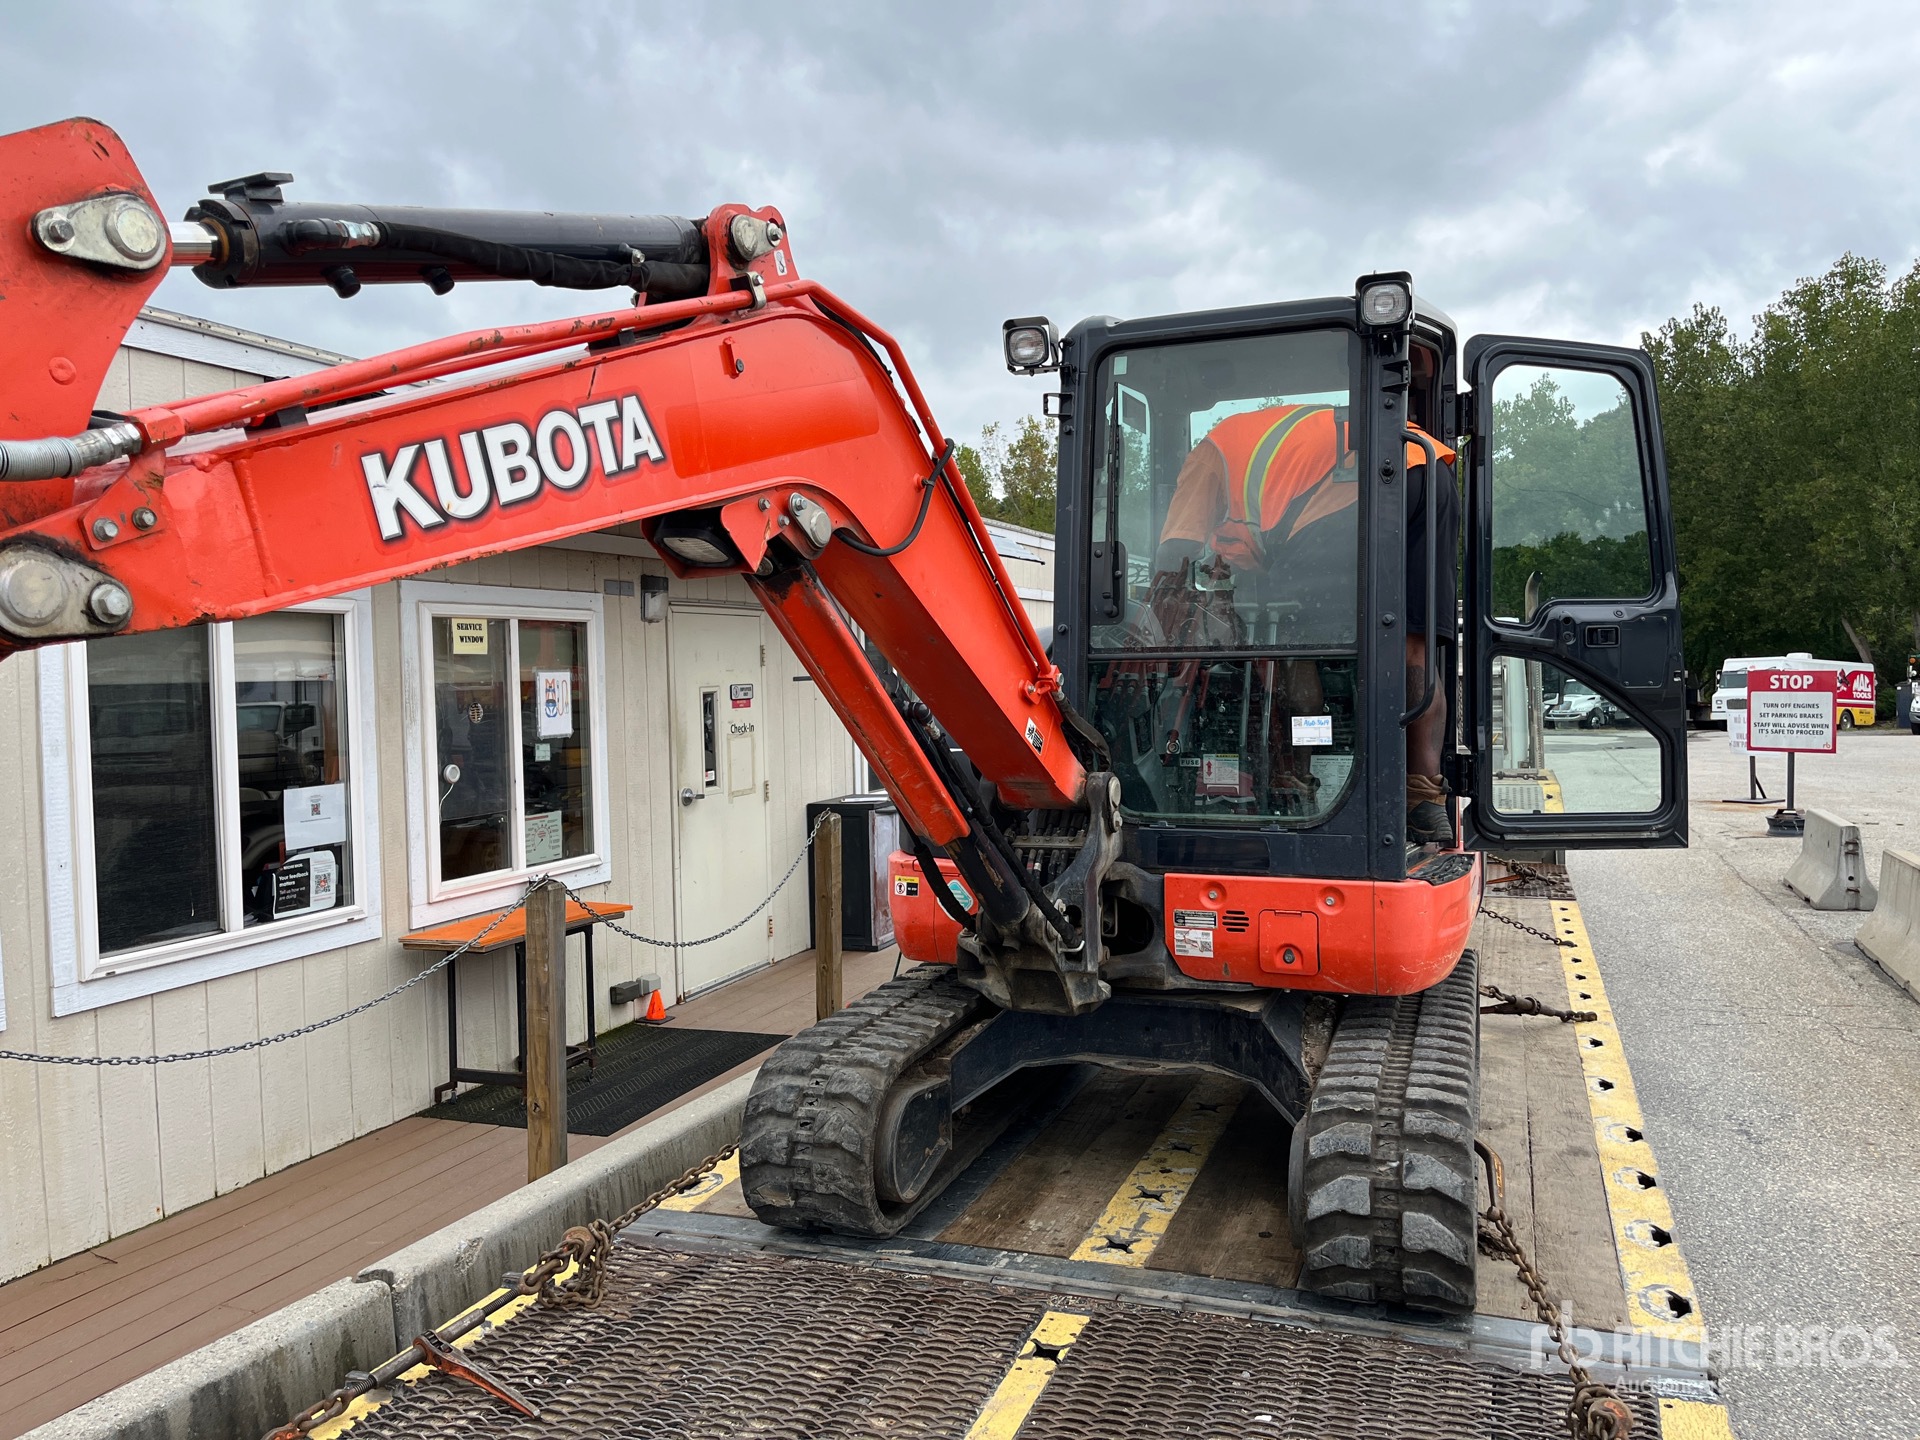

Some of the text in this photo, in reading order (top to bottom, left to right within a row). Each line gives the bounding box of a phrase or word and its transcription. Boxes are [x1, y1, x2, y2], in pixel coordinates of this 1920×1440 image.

[361, 395, 665, 541] KUBOTA
[456, 622, 482, 631] SERVICE
[459, 635, 484, 643] WINDOW
[1769, 674, 1814, 689] STOP
[1852, 691, 1872, 699] TOOLS
[730, 722, 754, 733] Check-In
[289, 871, 308, 879] feedback
